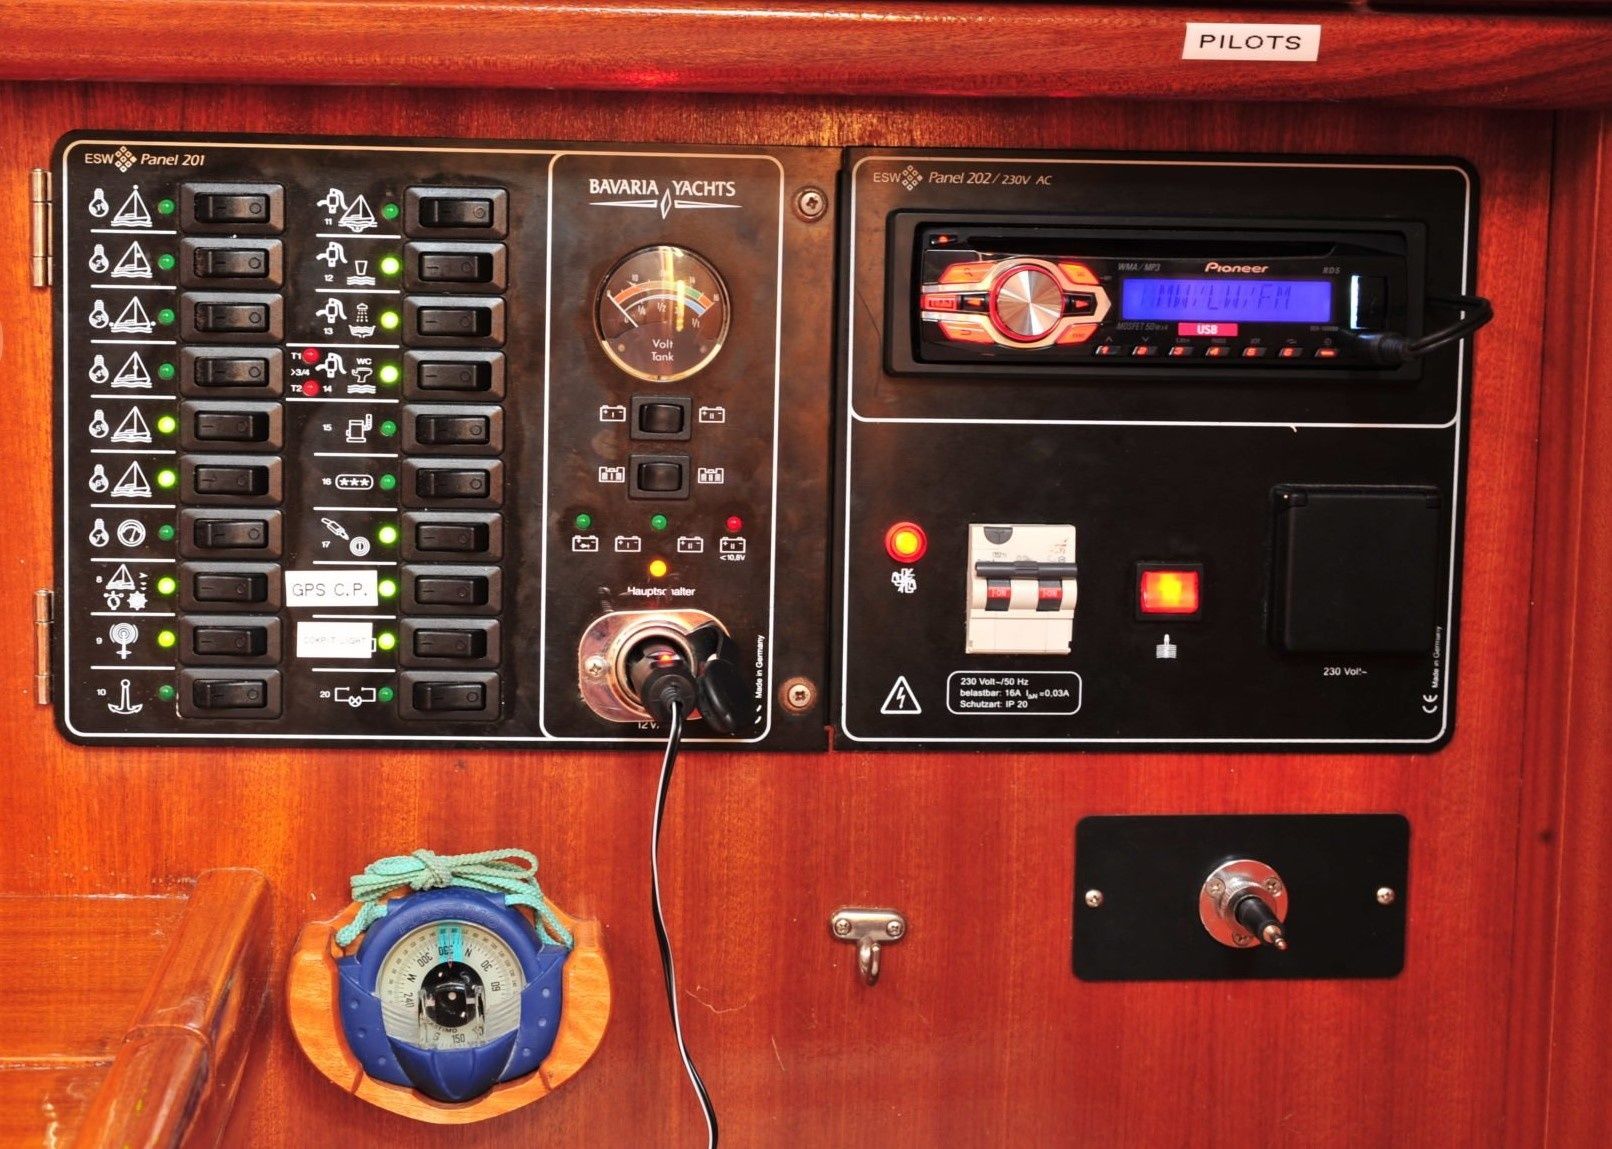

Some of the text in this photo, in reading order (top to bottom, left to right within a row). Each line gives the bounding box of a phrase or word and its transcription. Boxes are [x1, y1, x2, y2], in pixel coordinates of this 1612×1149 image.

[1199, 34, 1302, 51] PILOTS
[84, 153, 206, 166] ESW Panel 201
[872, 172, 901, 183] ESW
[928, 172, 965, 184] Panel
[1001, 174, 1031, 185] 230V
[1035, 175, 1053, 186] AC
[588, 178, 737, 197] BAVARIA YACHTS
[325, 218, 333, 226] 11
[1203, 261, 1270, 274] Pioneer
[324, 274, 334, 282] 12
[323, 327, 334, 335] 13
[1196, 324, 1219, 335] USB
[652, 338, 674, 350] Volt
[290, 352, 302, 360] T1
[651, 351, 675, 363] Tank
[290, 384, 303, 393] T2
[322, 385, 332, 393] 14
[321, 478, 332, 486] 16
[321, 540, 331, 549] 17
[292, 583, 368, 598] GPS C.P.
[755, 634, 766, 669] Germany
[755, 669, 763, 677] in
[1323, 666, 1341, 676] 230
[960, 677, 977, 686] 230
[1016, 677, 1029, 686] Hz
[1431, 667, 1440, 689] Made
[96, 688, 107, 697] 10
[754, 677, 763, 699] Made
[1004, 688, 1022, 697] 16A
[319, 690, 331, 698] 20
[1005, 700, 1015, 708] IP
[1016, 700, 1029, 708] 20
[416, 952, 434, 968] 300
[480, 960, 493, 973] 30
